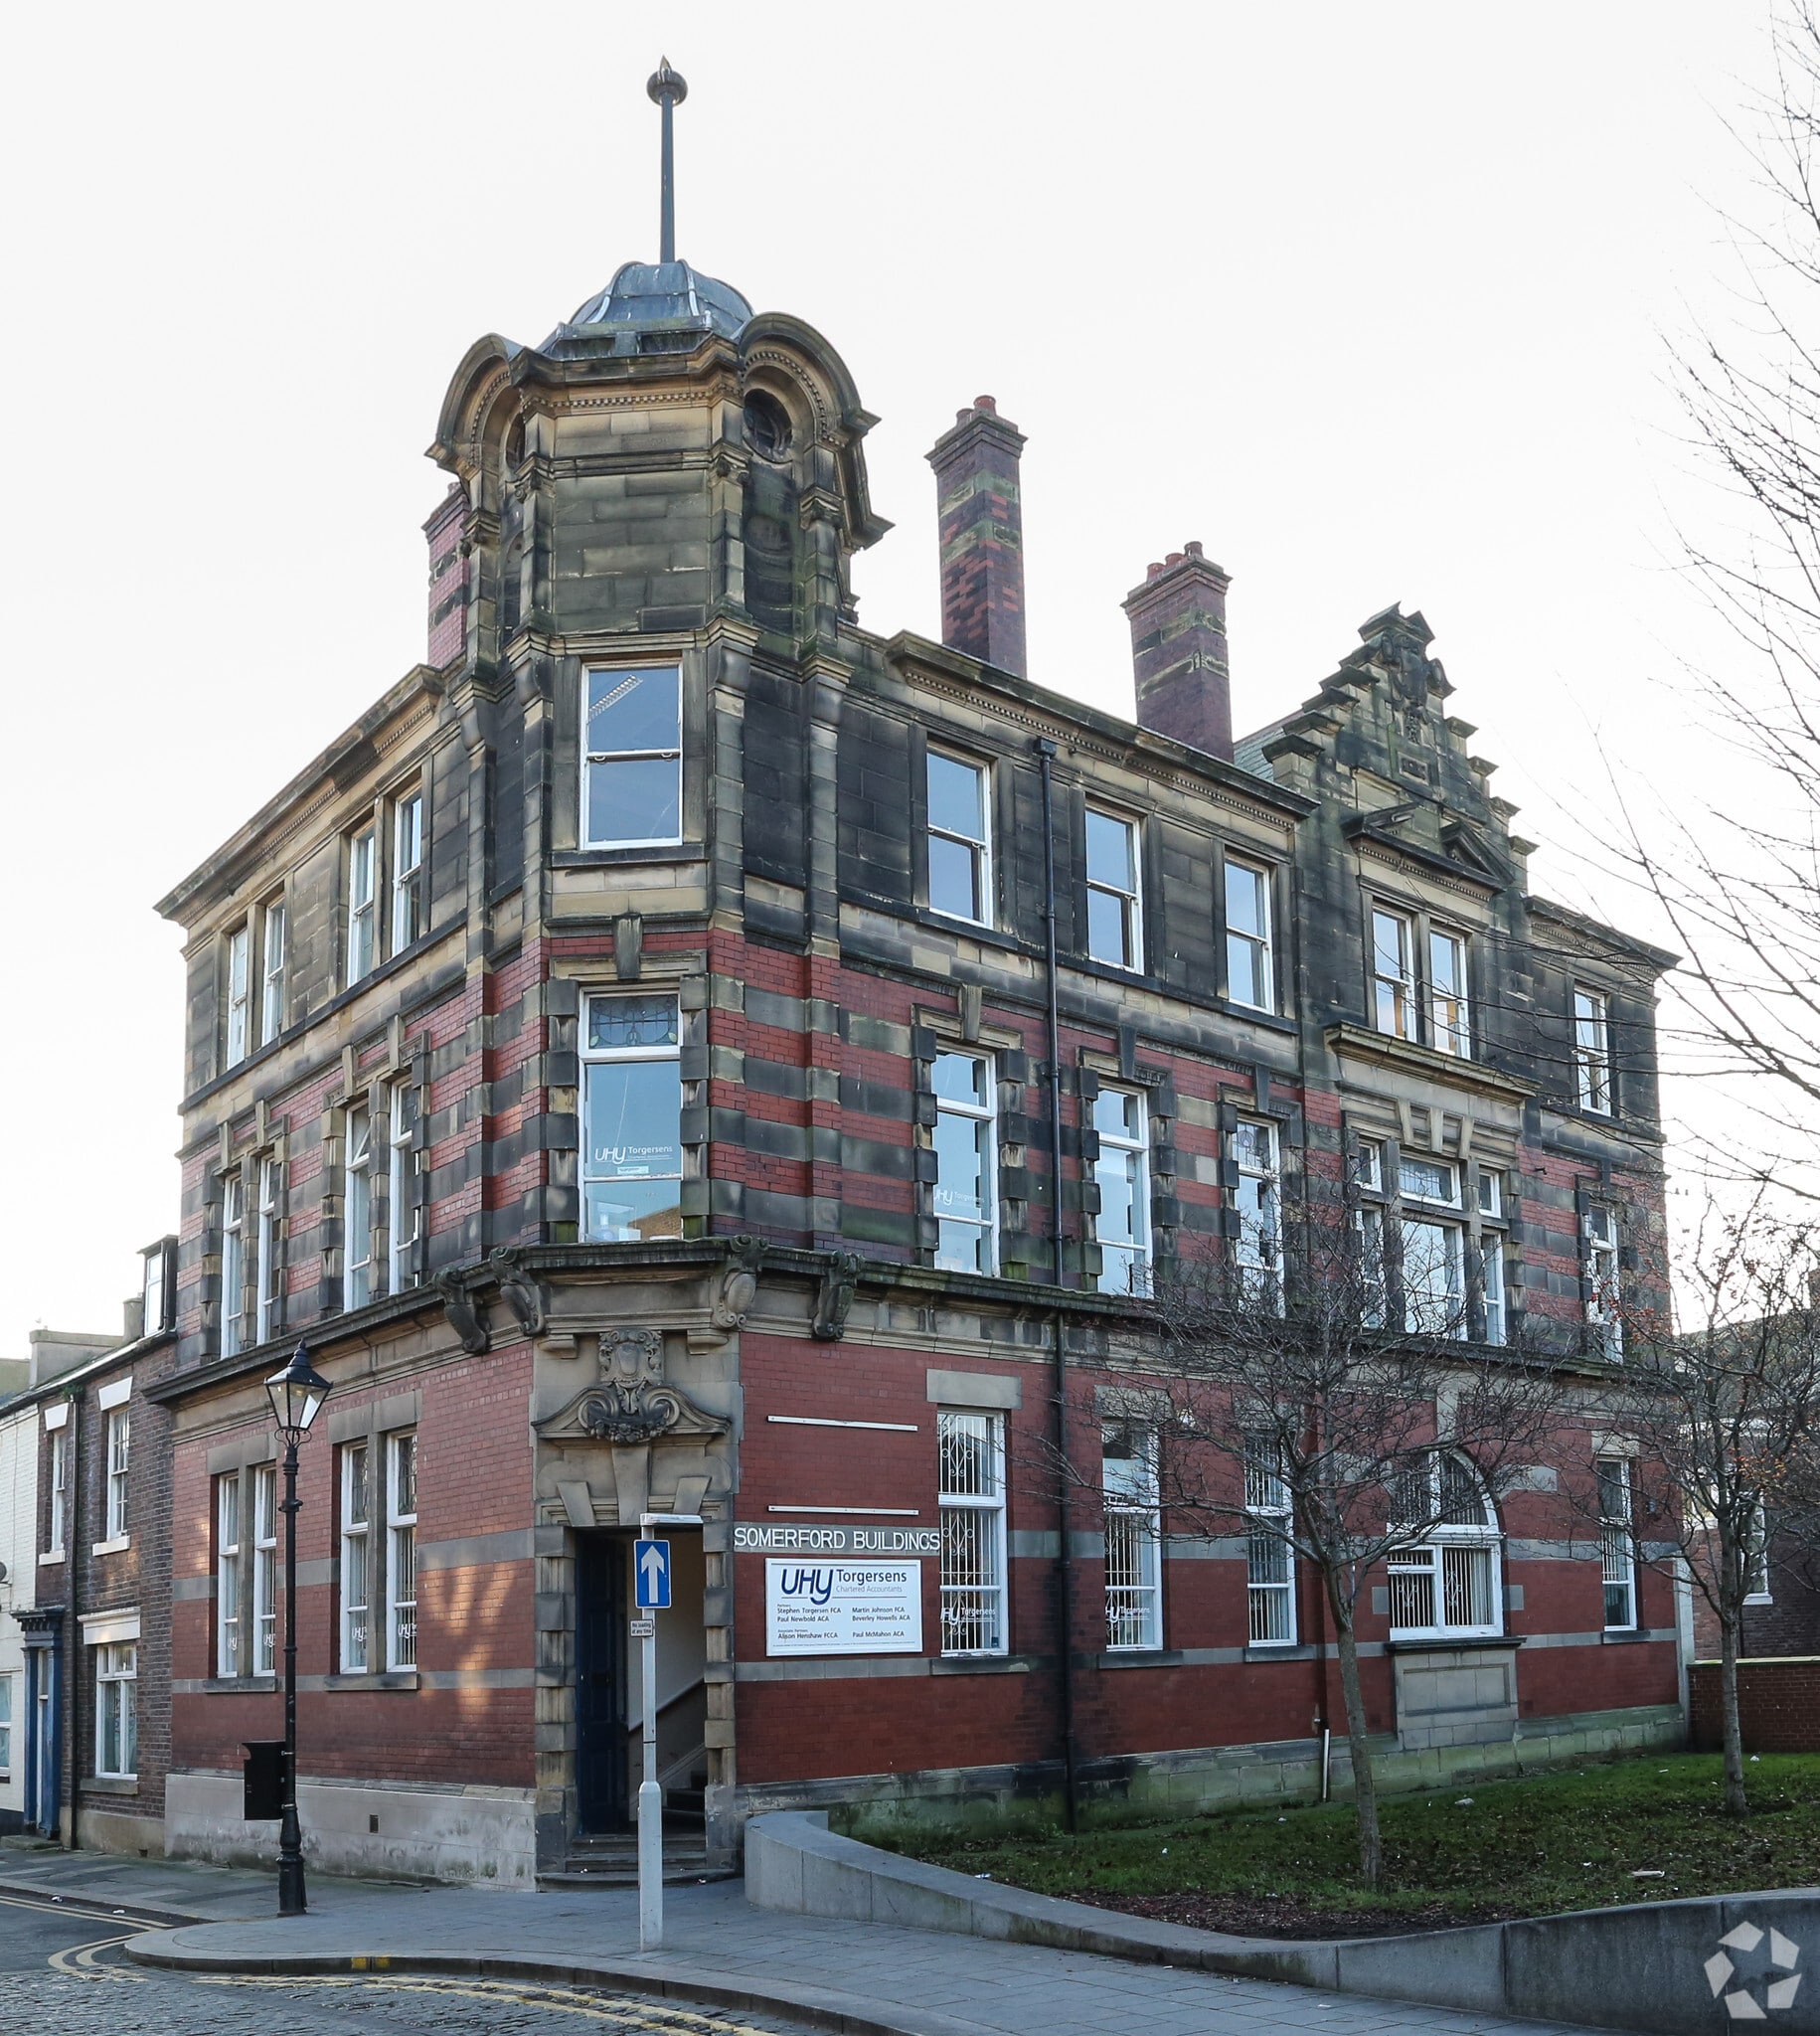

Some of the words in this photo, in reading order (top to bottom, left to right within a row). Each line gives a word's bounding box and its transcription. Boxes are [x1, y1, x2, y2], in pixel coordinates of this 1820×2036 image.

[734, 1527, 846, 1550] SOMERFORD
[853, 1530, 940, 1551] BUILDINGS
[836, 1569, 908, 1586] Torgersens
